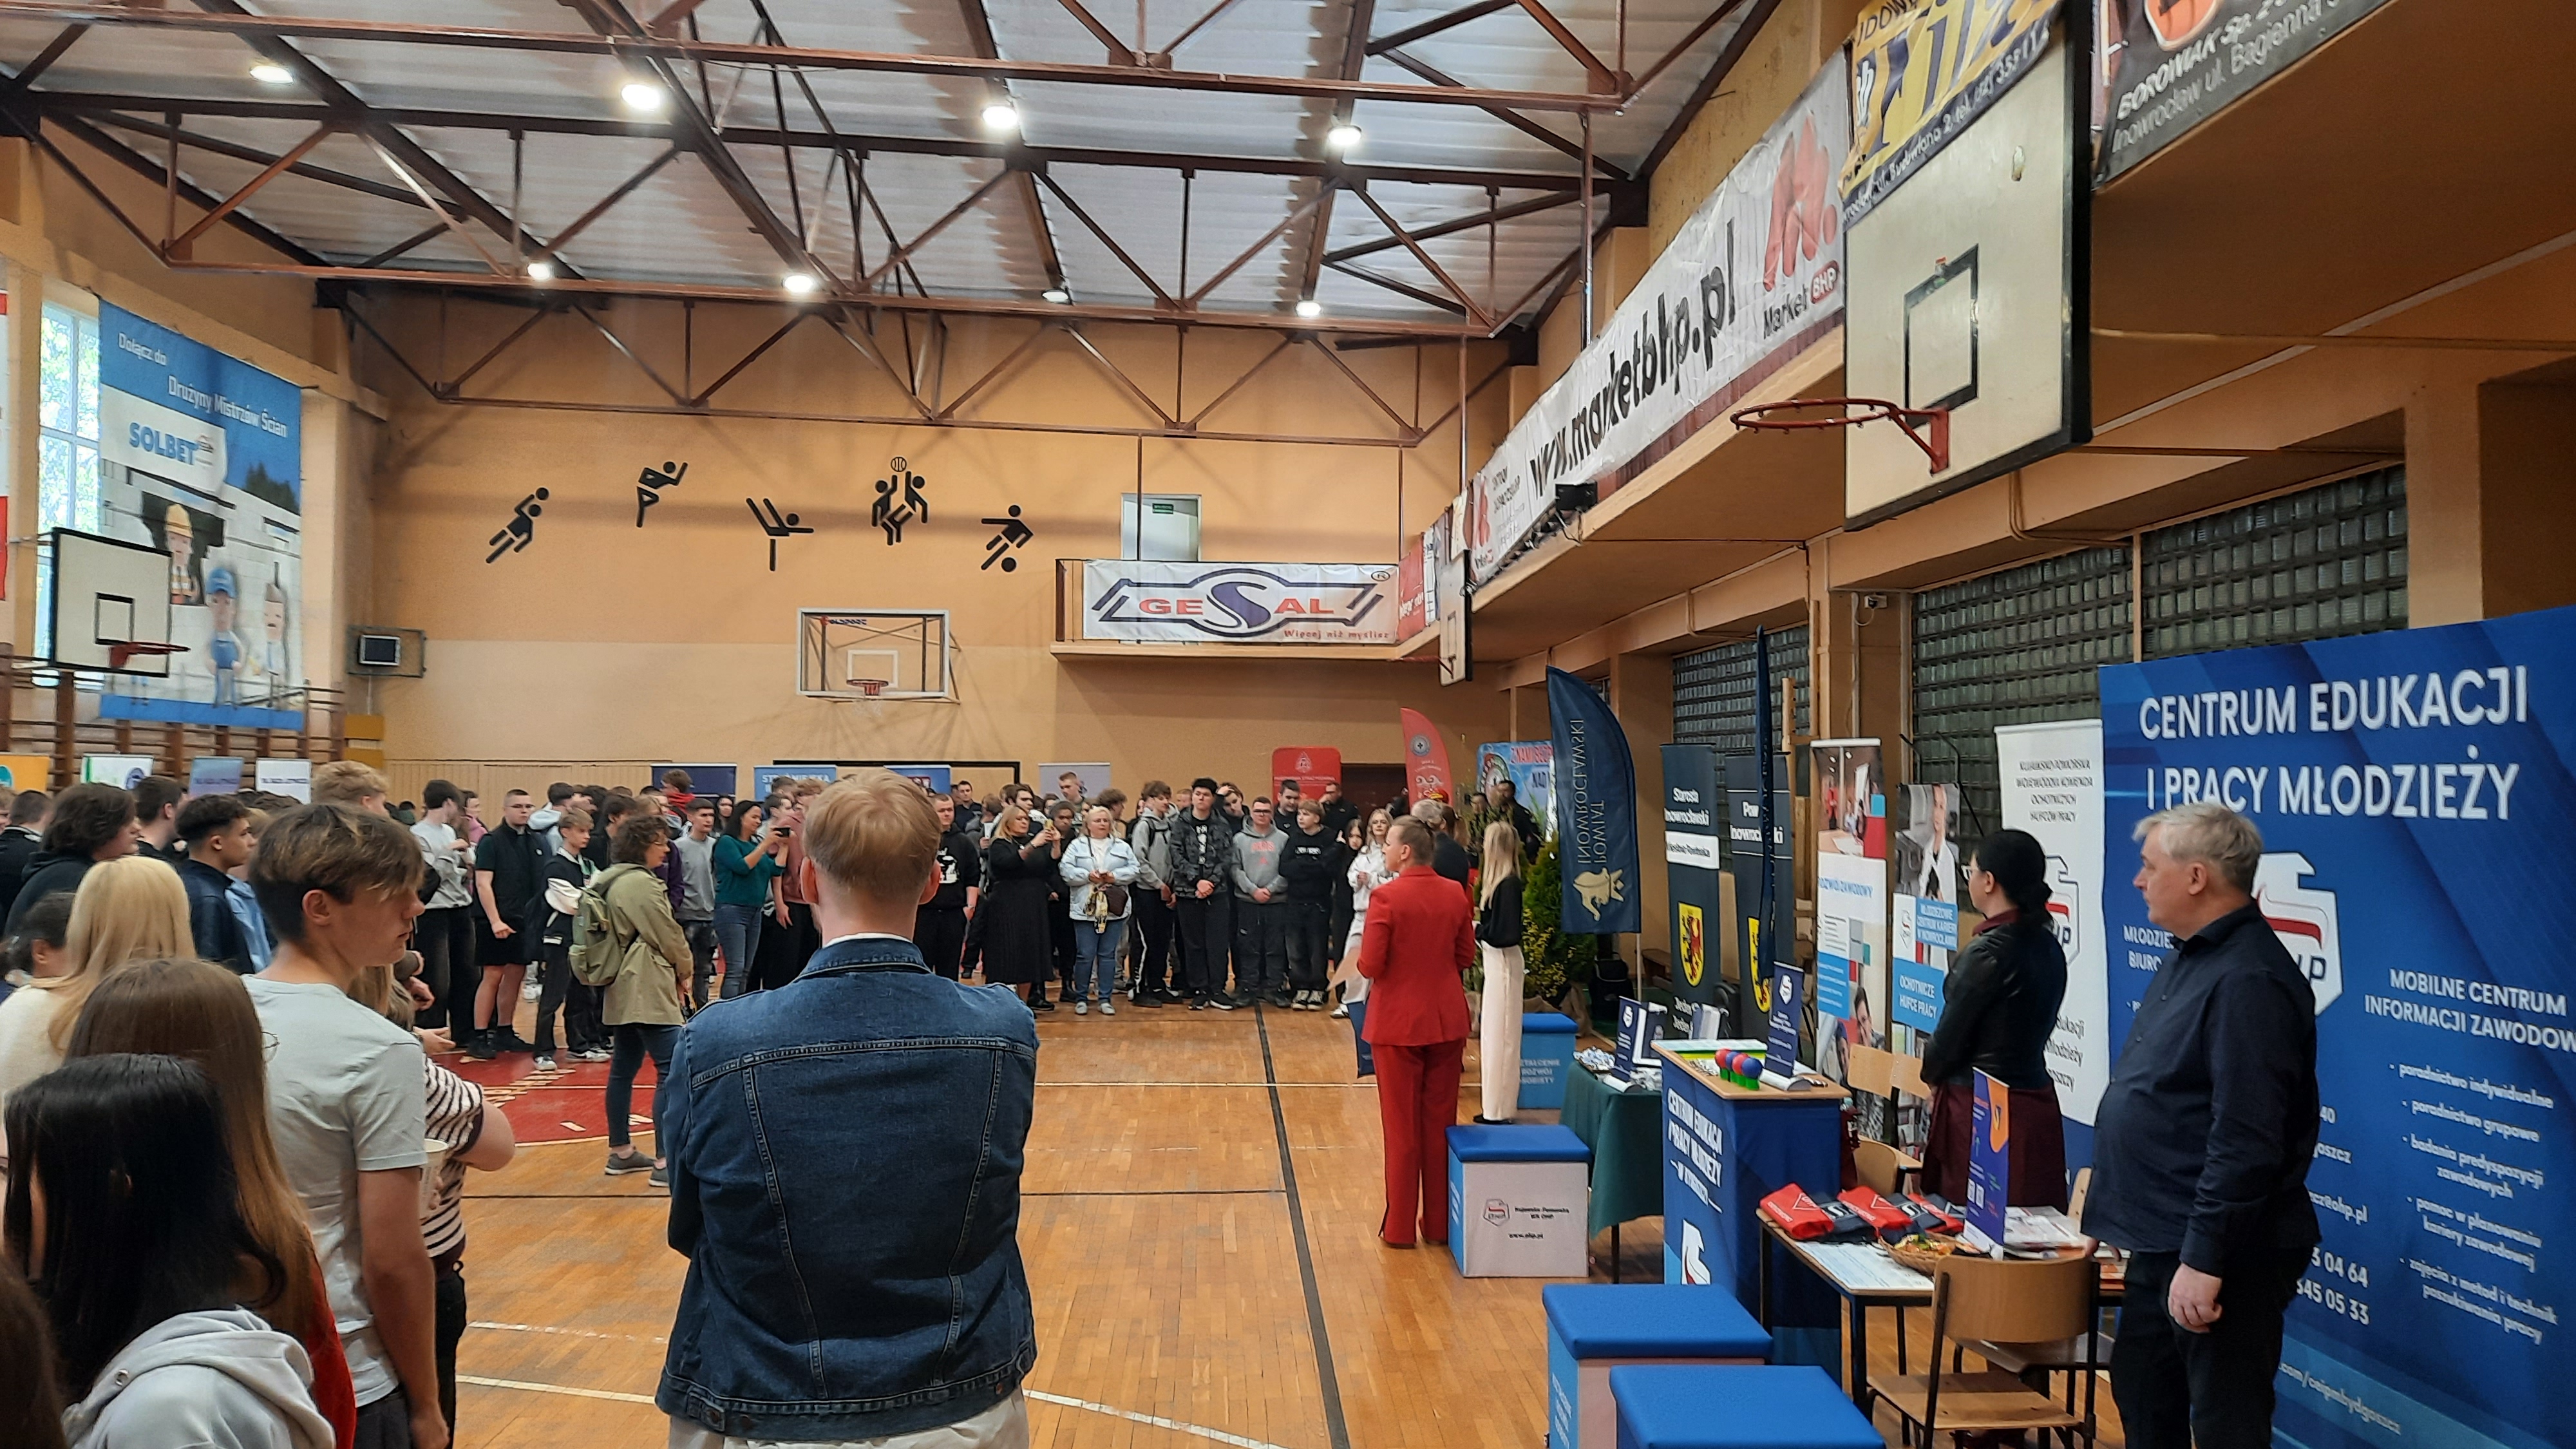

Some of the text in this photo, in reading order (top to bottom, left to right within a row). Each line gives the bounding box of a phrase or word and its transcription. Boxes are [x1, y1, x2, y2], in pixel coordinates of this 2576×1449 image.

[2117, 26, 2222, 120] BOROWIAK
[1942, 113, 1954, 134] 2
[1812, 266, 1839, 299] BHP
[1763, 282, 1808, 339] Market
[154, 348, 167, 366] do
[168, 374, 213, 413] Drużyny
[261, 408, 288, 438] Ścian
[129, 421, 198, 466] SOLBET
[2139, 665, 2528, 741] CENTRUM EDUKACJI
[2147, 744, 2519, 821] I PRACY MŁODZIEŻY
[1899, 973, 1935, 999] OCHOTNICZE
[2389, 968, 2568, 1017] MOBILNE CENTRUM
[1900, 994, 1937, 1020] HUFCE PRACY
[2364, 994, 2467, 1033] INFORMACJI
[2399, 1063, 2554, 1110] poradnictwo indywidualne
[2411, 1100, 2541, 1142] poradnictwo grupowe
[2313, 1141, 2352, 1164] oszcz
[2410, 1133, 2544, 1190] badania predyspozycji
[2436, 1165, 2514, 1200] zawodowych
[2324, 1251, 2344, 1278] 04
[2348, 1262, 2369, 1289] 64
[2325, 1287, 2345, 1315] 05
[2349, 1298, 2371, 1326] 33
